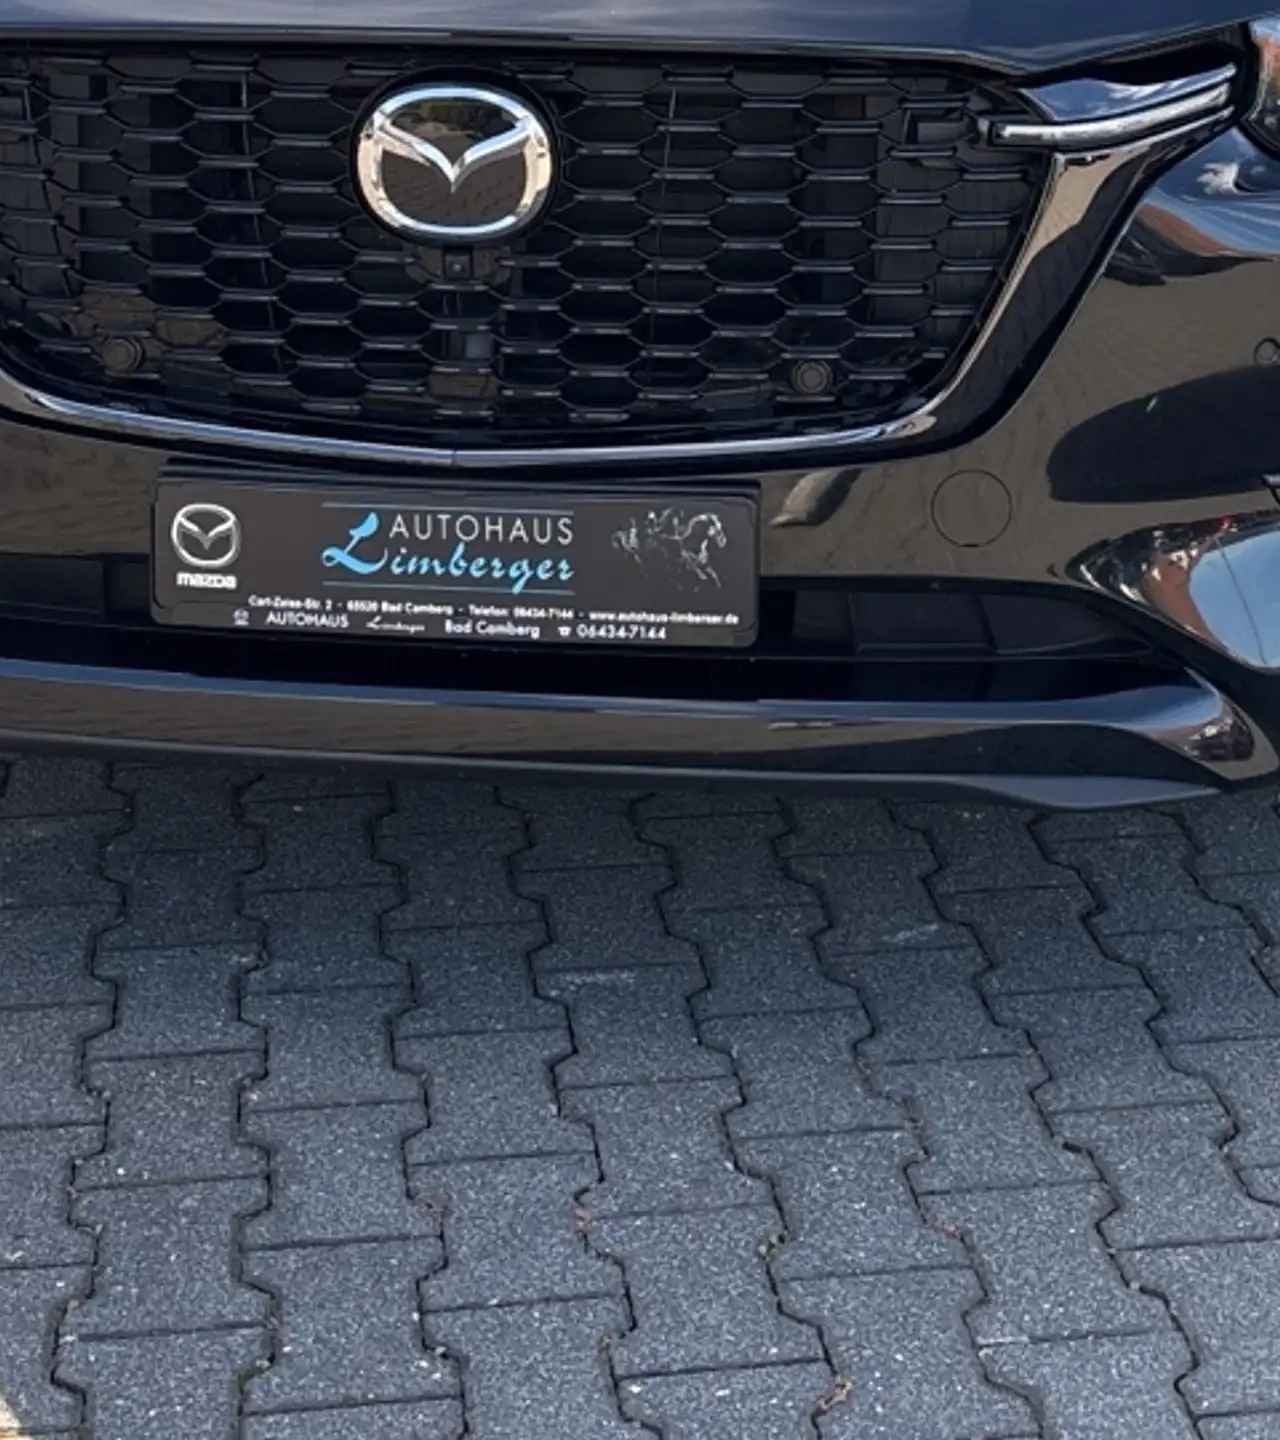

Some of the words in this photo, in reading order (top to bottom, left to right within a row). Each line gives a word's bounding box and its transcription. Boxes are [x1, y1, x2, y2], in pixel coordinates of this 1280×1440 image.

[389, 512, 574, 545] AUTOHAUS
[322, 511, 575, 594] Limberger
[176, 571, 237, 589] mazda
[265, 610, 349, 629] AUTOHAUS
[444, 618, 472, 635] Bad
[476, 620, 540, 640] Camberg
[576, 623, 666, 640] 06434-7144
